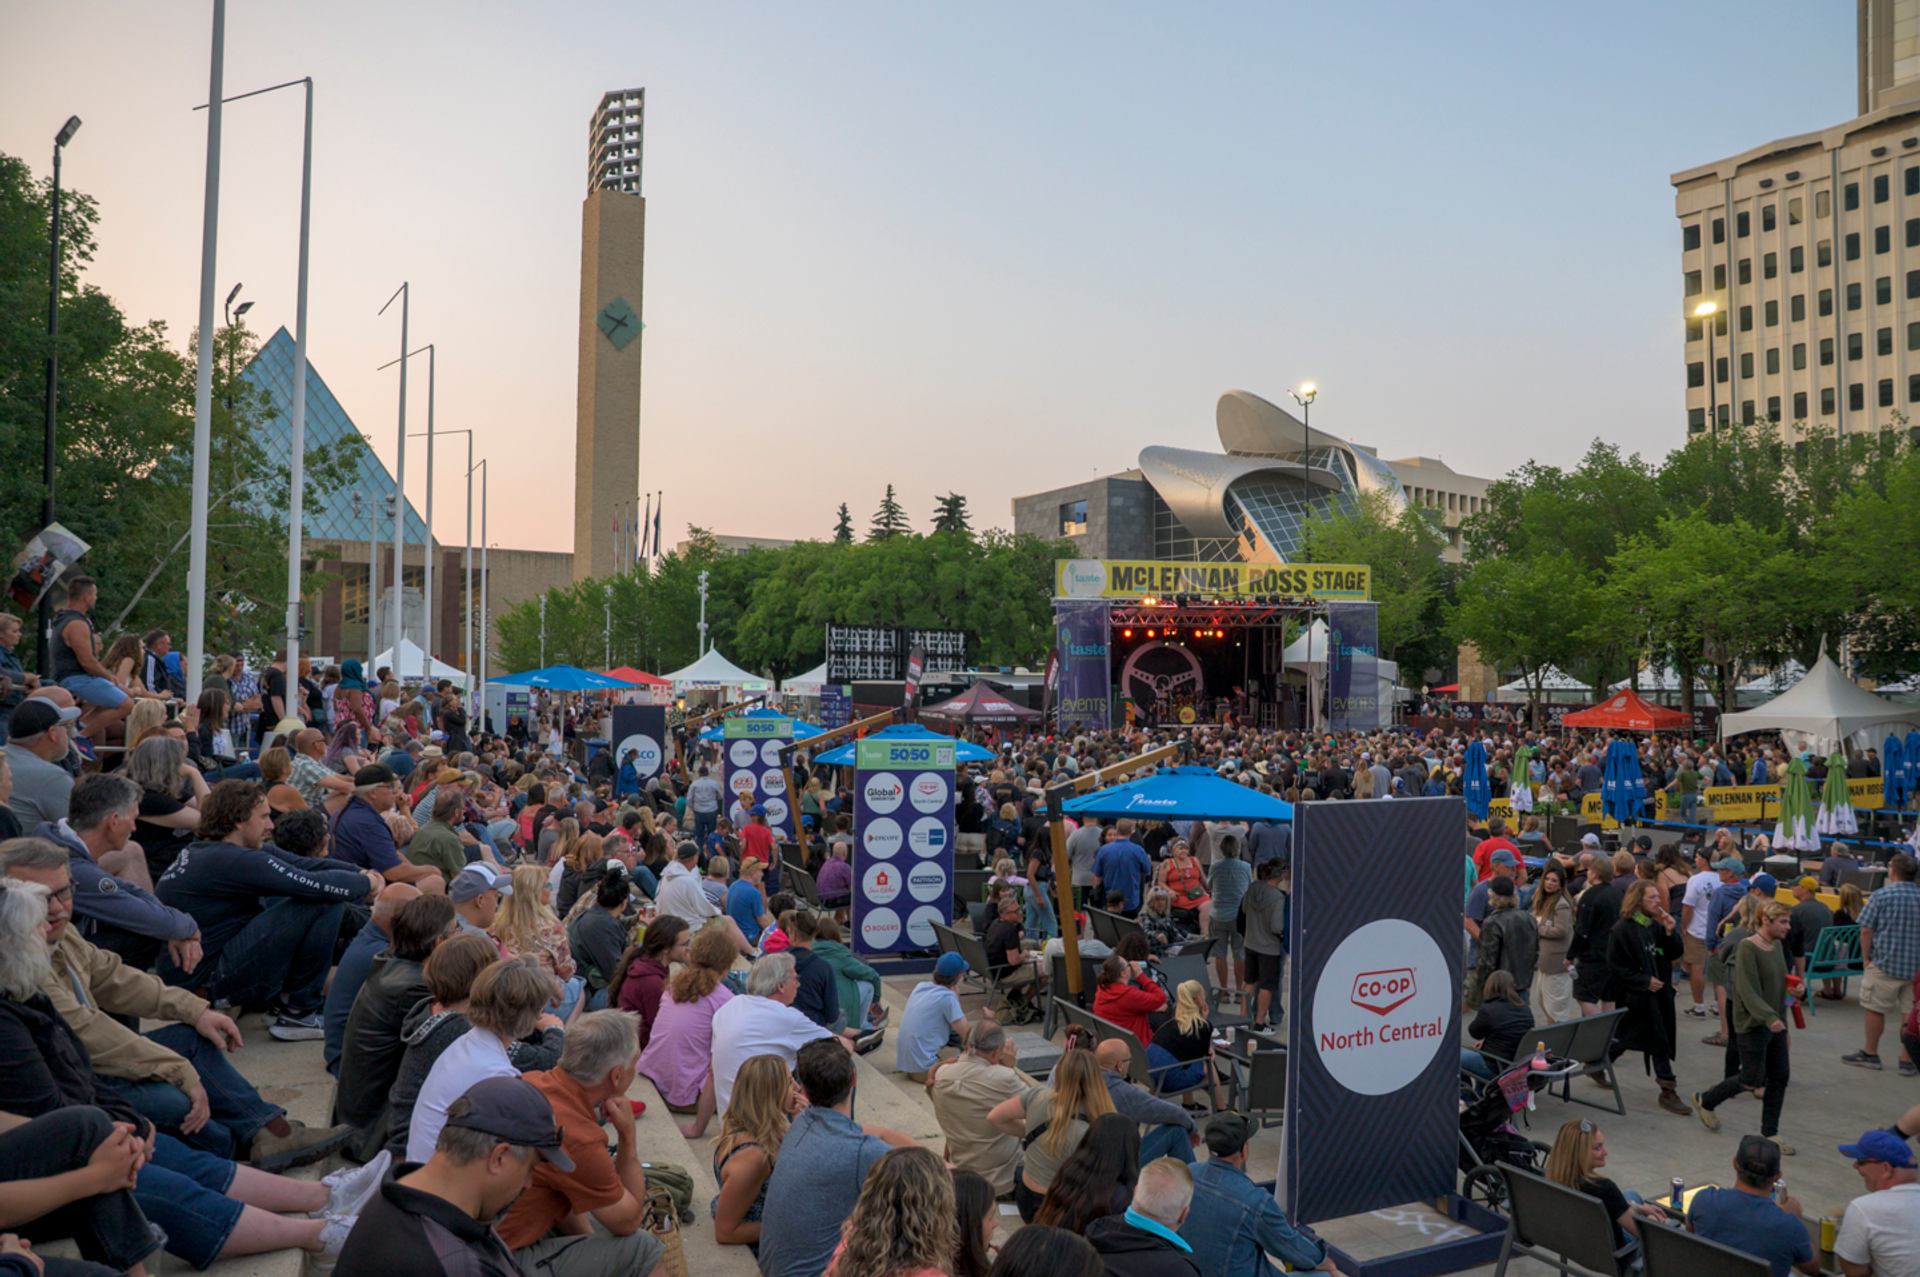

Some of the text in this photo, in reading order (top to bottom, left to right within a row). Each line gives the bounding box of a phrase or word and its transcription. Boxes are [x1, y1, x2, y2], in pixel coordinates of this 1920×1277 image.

[1249, 568, 1308, 593] ROSS
[1312, 570, 1366, 591] STAGE
[1070, 643, 1106, 656] taste
[1340, 643, 1376, 656] taste
[867, 787, 896, 797] Global
[1488, 806, 1513, 818] ROSS
[267, 858, 350, 896] THE ALOHA STATE
[871, 924, 899, 932] ROGERS
[1320, 1016, 1443, 1051] North Central
